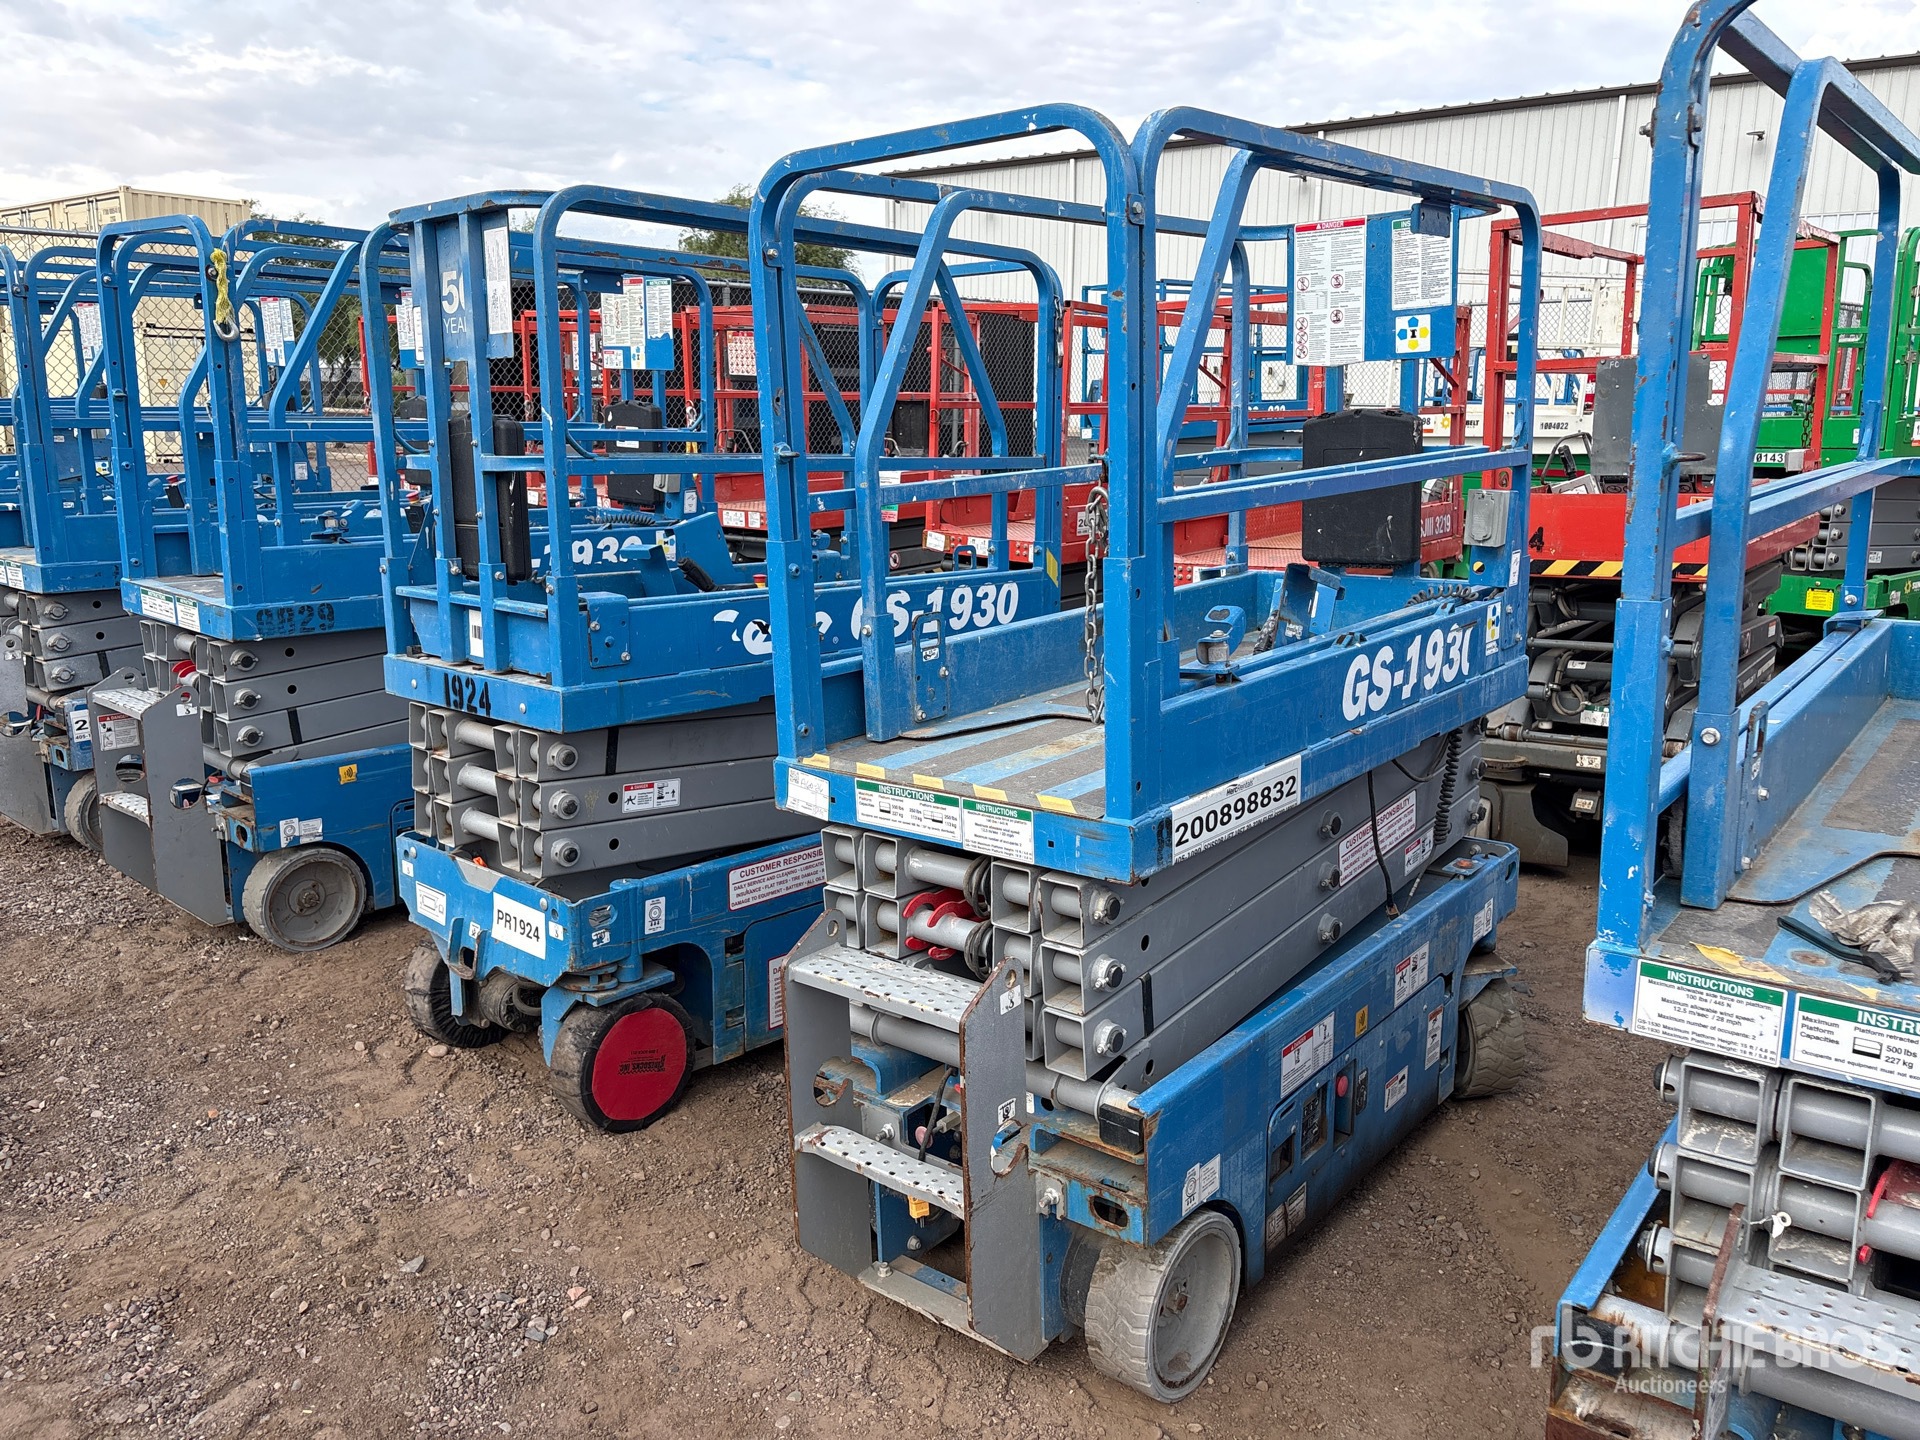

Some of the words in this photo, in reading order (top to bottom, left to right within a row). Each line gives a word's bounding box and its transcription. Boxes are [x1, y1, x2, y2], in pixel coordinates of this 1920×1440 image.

[1321, 221, 1344, 230] DANGER
[1434, 513, 1452, 535] 3219
[443, 672, 492, 718] 1924
[878, 785, 934, 802] INSTRUCTIONS
[975, 802, 1017, 817] INSTRUCTIONS
[1174, 773, 1296, 848] 200898832
[739, 859, 781, 878] CUSTOMER
[496, 908, 541, 944] PR1924
[1666, 969, 1754, 998] INSTRUCTIONS
[1799, 1030, 1839, 1045] Capacities
[1800, 1022, 1834, 1035] Platform
[1800, 1014, 1839, 1028] Maximum
[1853, 1025, 1884, 1038] Platform
[1885, 1032, 1919, 1045] retracted
[1885, 1044, 1902, 1055] 500
[1903, 1048, 1917, 1058] lbs
[1884, 1054, 1900, 1065] 227
[1902, 1059, 1913, 1069] kg
